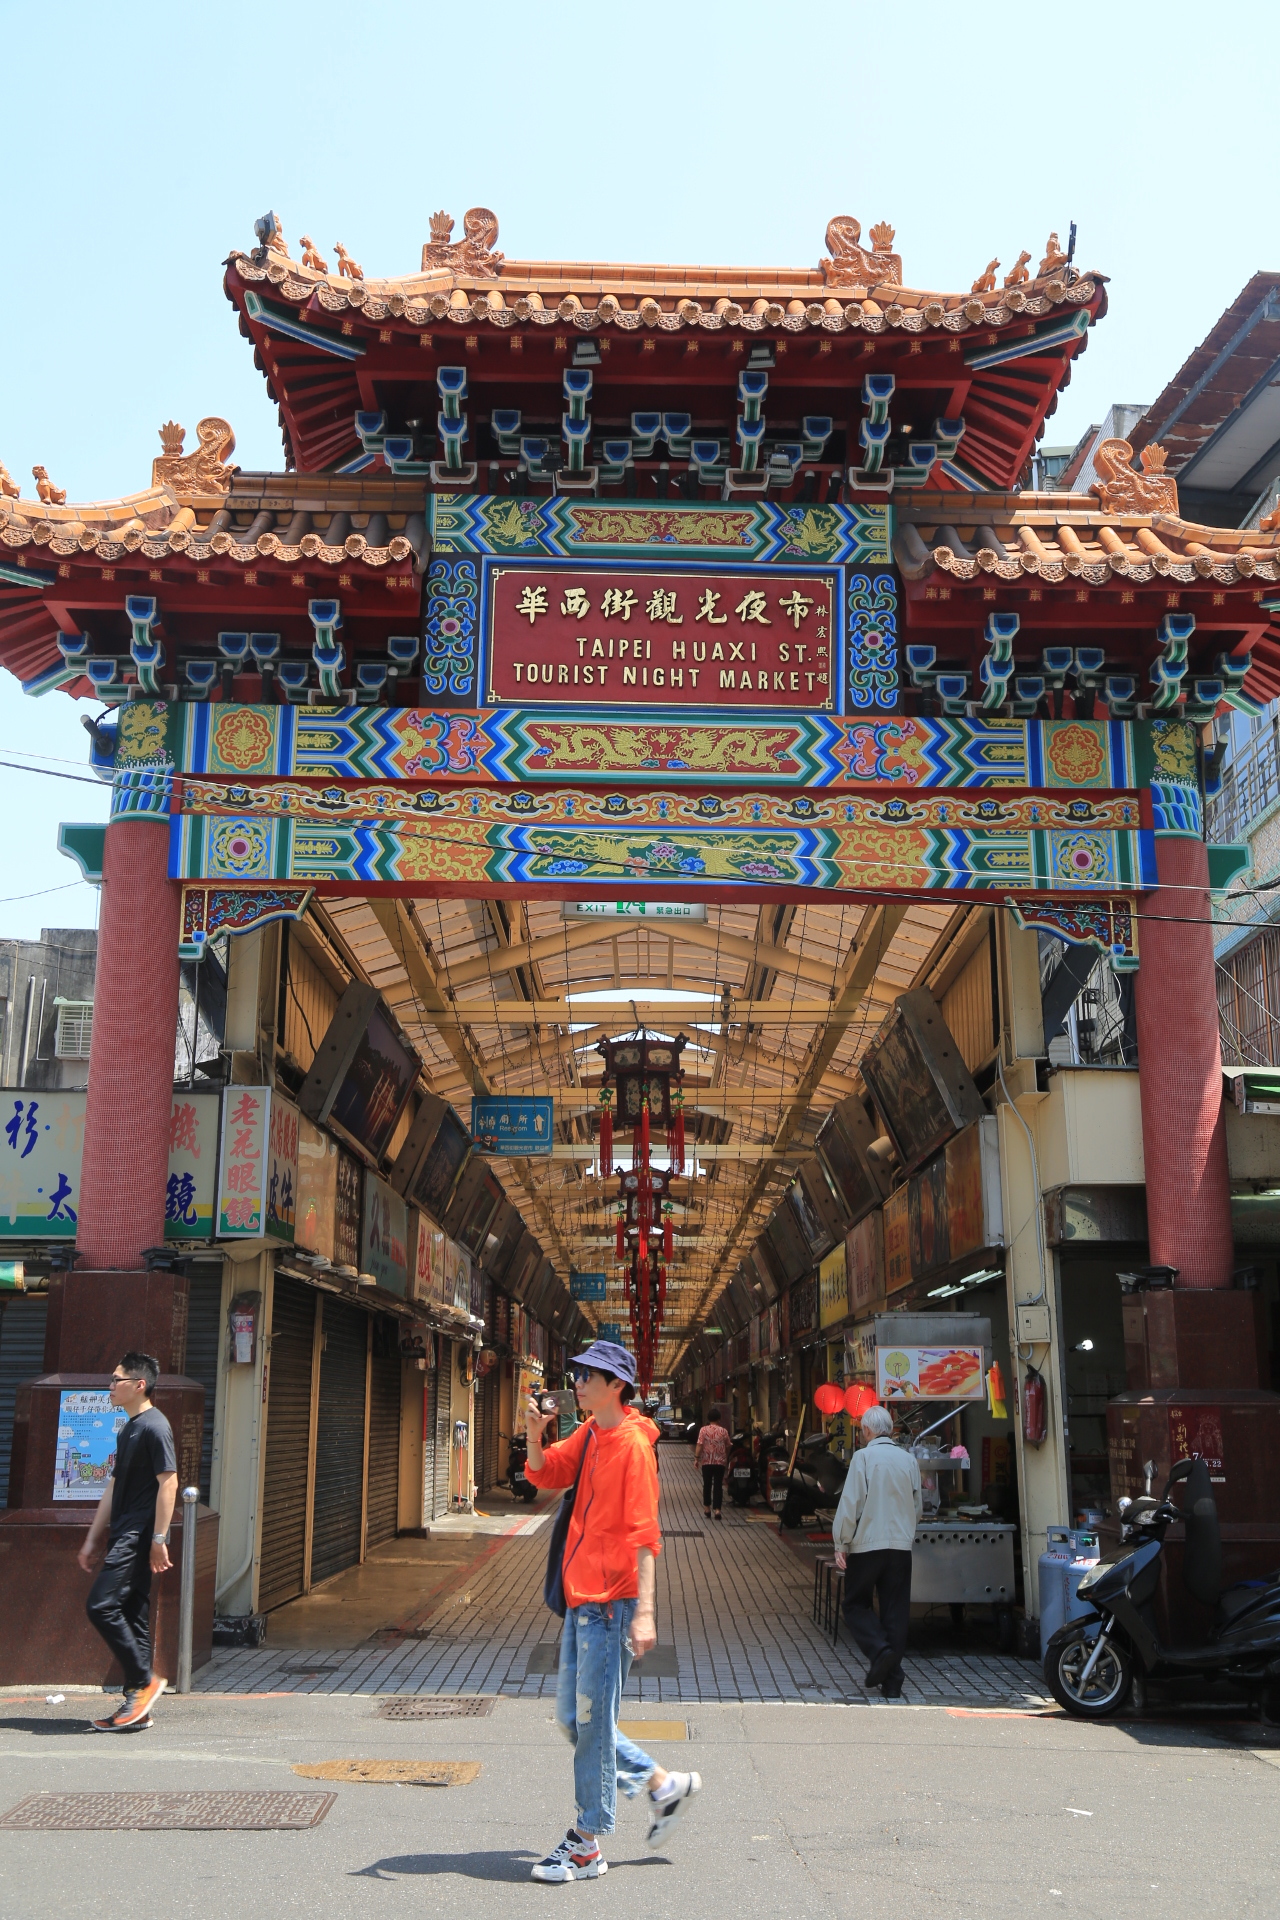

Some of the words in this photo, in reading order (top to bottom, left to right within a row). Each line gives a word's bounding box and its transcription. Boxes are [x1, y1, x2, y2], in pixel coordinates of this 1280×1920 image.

[515, 586, 815, 628] 華西街觀光夜市
[576, 637, 652, 660] TAIPEI
[672, 640, 758, 662] HUAXI
[778, 643, 812, 663] ST.
[513, 663, 609, 685] TOURIST
[622, 666, 700, 688] NIGHT
[719, 669, 816, 692] MARKET
[576, 904, 608, 912] EXIT
[656, 906, 691, 915] 緊急出口
[223, 1092, 261, 1230] 老花眼鏡
